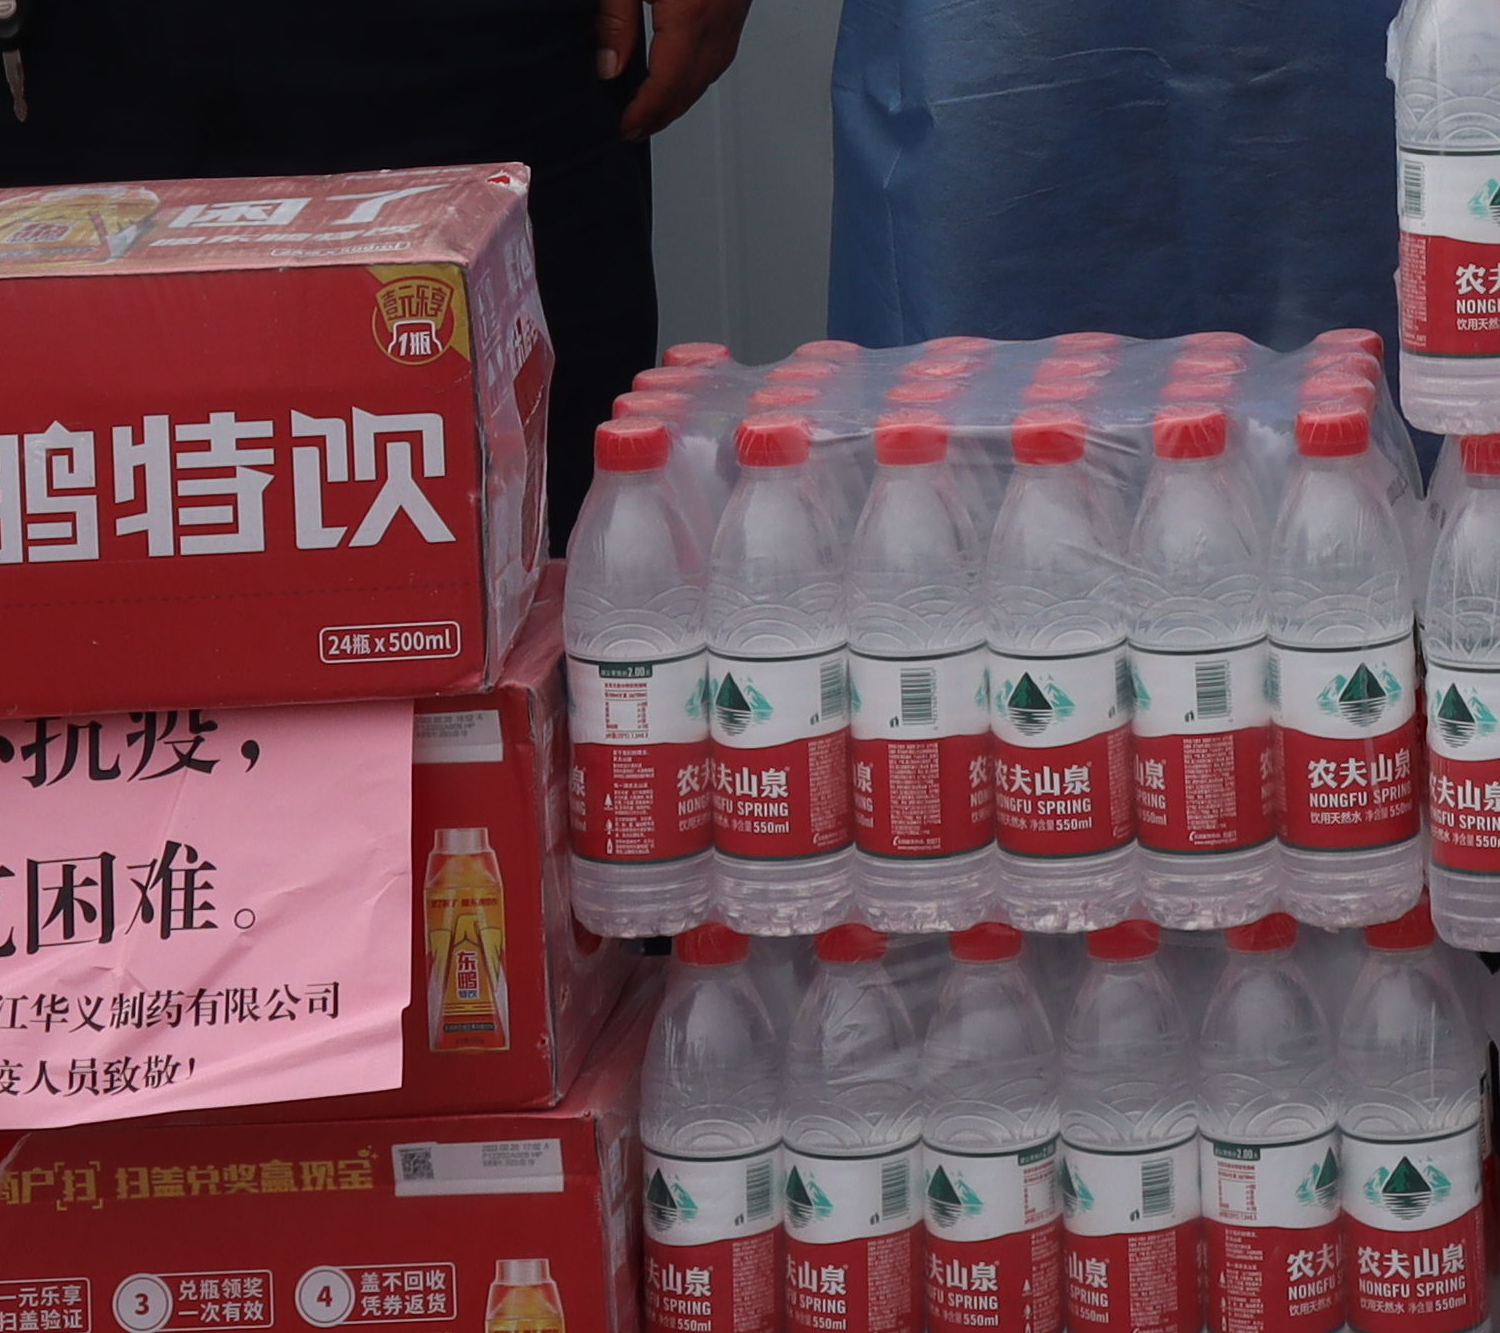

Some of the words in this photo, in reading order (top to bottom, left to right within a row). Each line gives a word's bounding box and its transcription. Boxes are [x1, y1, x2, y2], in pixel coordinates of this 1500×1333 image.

[167, 183, 450, 229] 困了
[398, 331, 431, 357] 1瓶
[1308, 748, 1411, 789] 农夫山泉
[1037, 796, 1092, 815] SPRING
[1309, 791, 1368, 808] NONGFU
[1372, 786, 1412, 805] SPRING
[115, 1158, 375, 1200] 扫盖兑奖赢现金
[1357, 1243, 1466, 1278] 农夫山泉
[178, 1279, 264, 1302] 兑瓶领奖
[360, 1269, 446, 1292] 盖不回收
[1359, 1280, 1411, 1299] NONGFU
[1416, 1277, 1467, 1296] SPRING
[133, 1292, 151, 1316] 3
[315, 1285, 333, 1308] 4
[360, 1294, 447, 1316] 凭券返货
[178, 1301, 265, 1324] 一次有效
